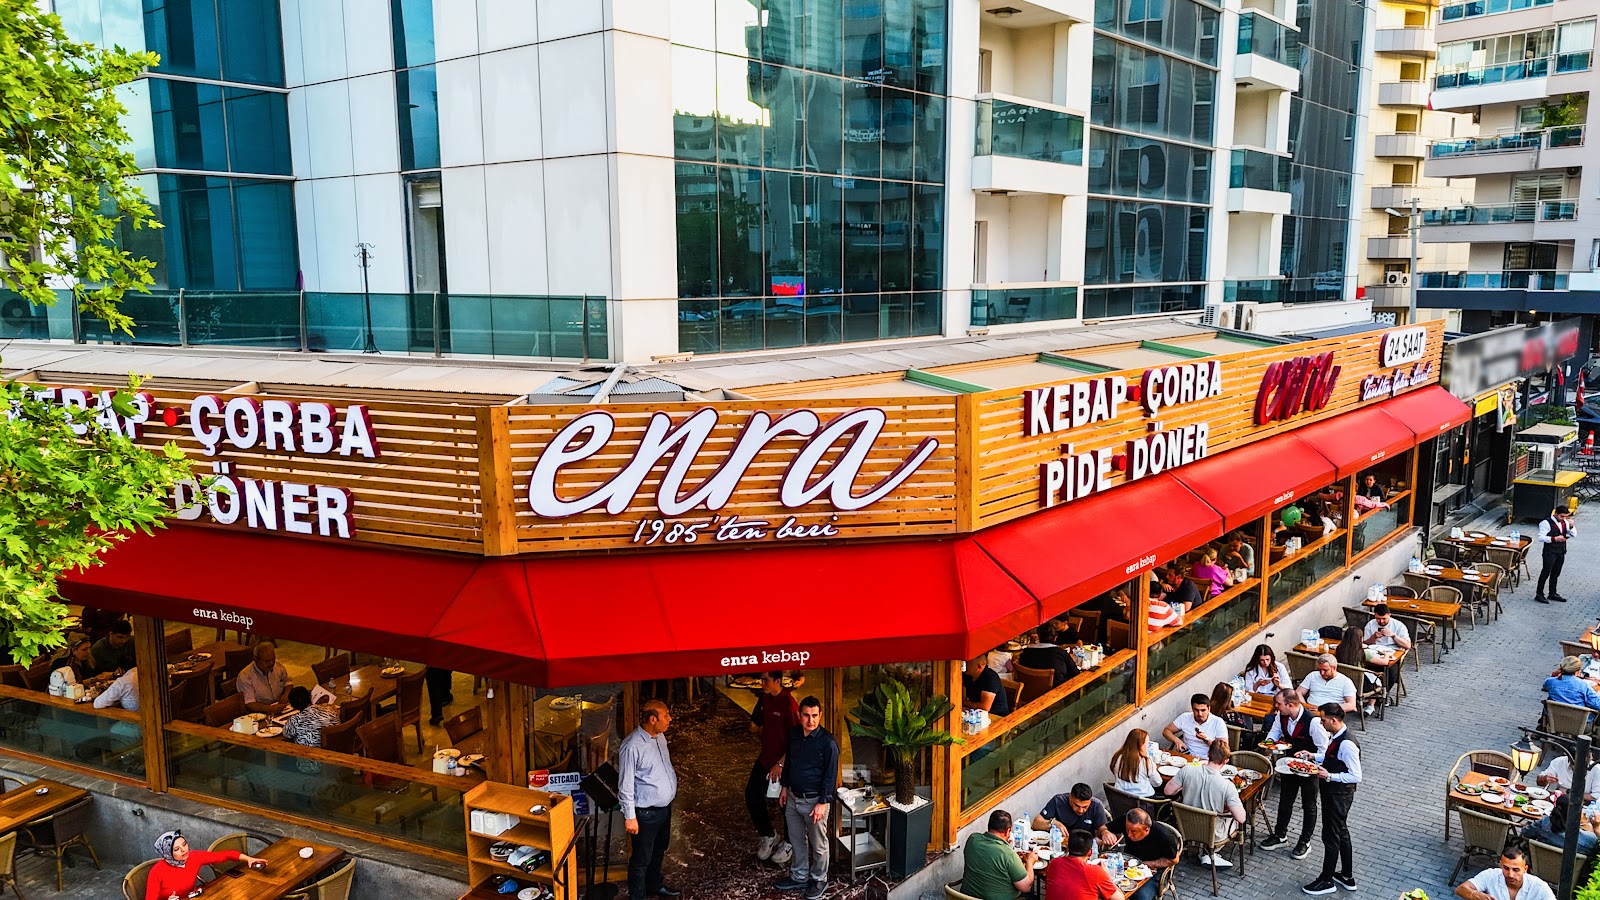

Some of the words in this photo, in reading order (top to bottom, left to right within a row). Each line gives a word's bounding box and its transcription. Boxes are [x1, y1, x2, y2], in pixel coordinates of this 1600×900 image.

[1388, 337, 1400, 362] 24
[1402, 332, 1424, 358] SAAT
[1026, 376, 1128, 437] KEBAP
[1144, 360, 1222, 419] ÇORBA
[7, 385, 150, 439] BAP
[190, 395, 377, 458] ÇORBA
[528, 406, 940, 518] enra
[1045, 443, 1113, 508] PİDE
[1131, 420, 1209, 481] DÖNER
[174, 461, 353, 539] DÖNER
[633, 514, 770, 546] 1985'ten
[775, 514, 840, 540] beri
[1125, 562, 1140, 575] enra
[192, 603, 218, 620] enra
[220, 609, 254, 630] kebap
[720, 654, 759, 667] enra
[761, 649, 811, 667] kebap
[549, 774, 579, 784] SETCARD
